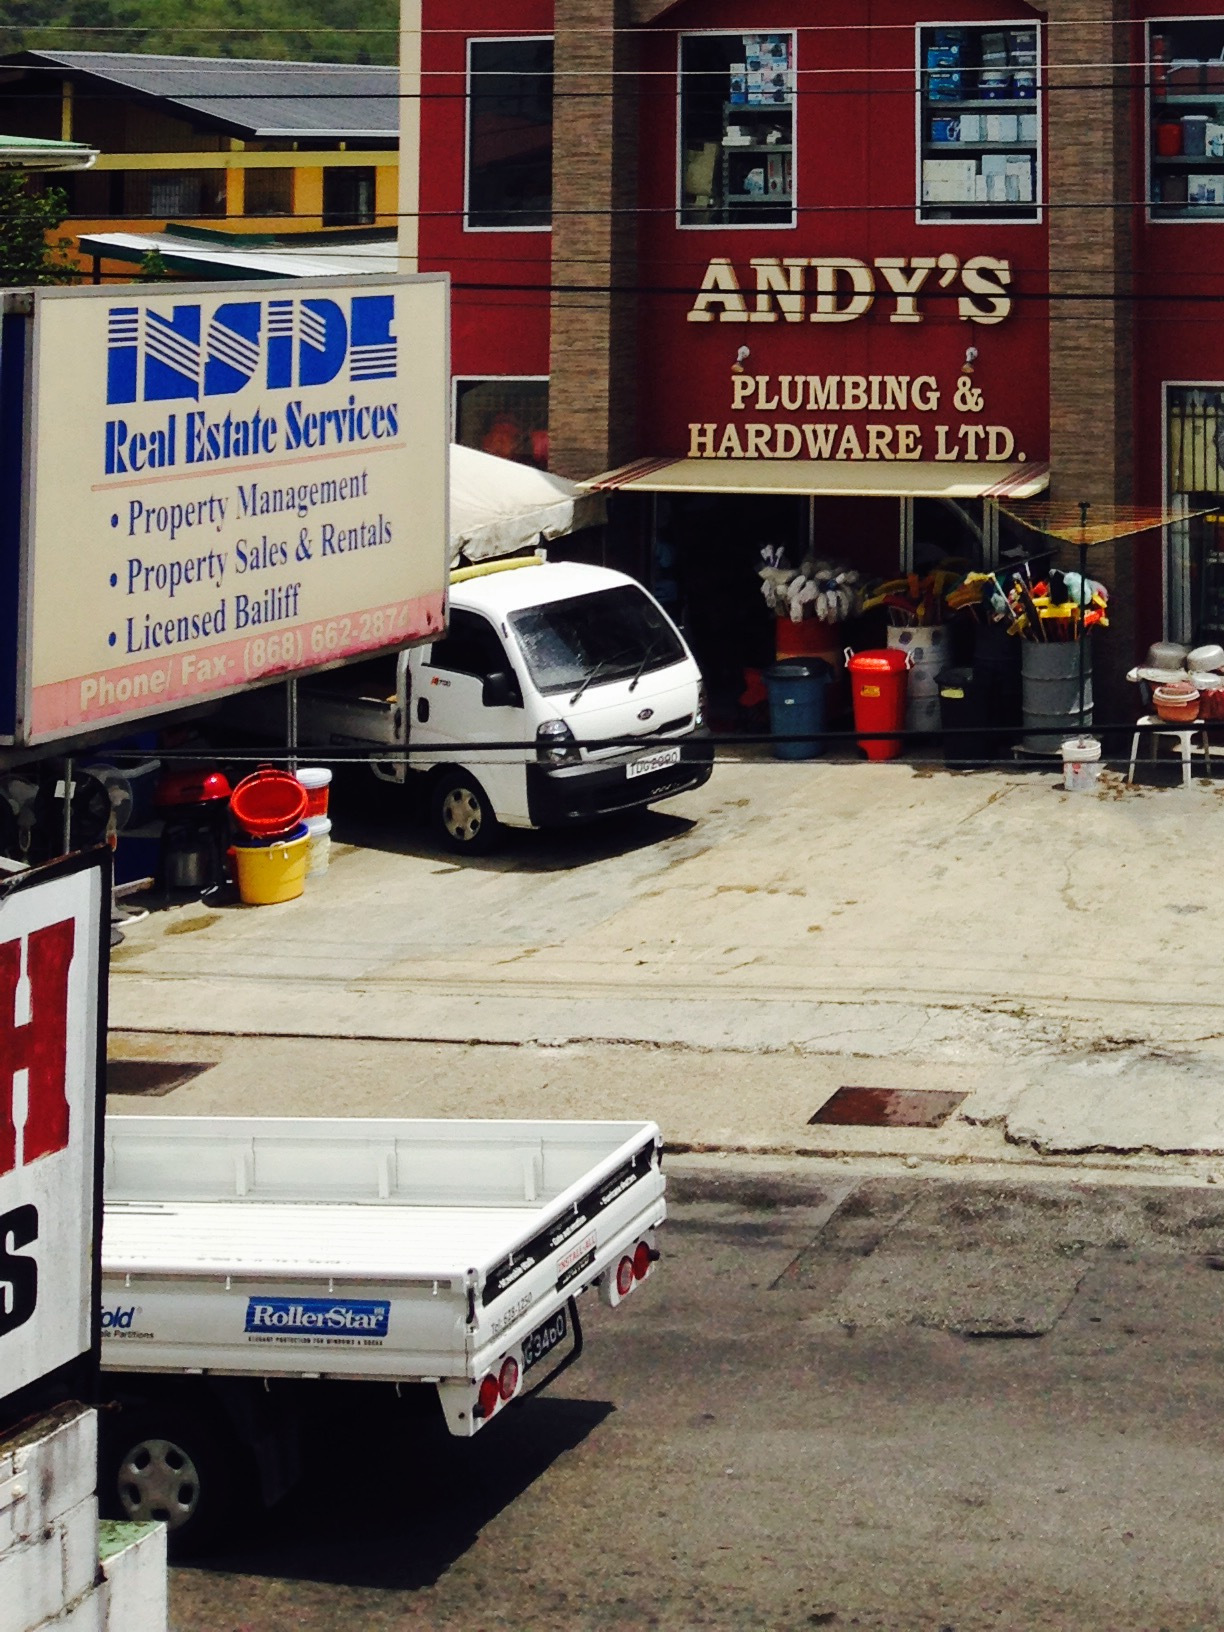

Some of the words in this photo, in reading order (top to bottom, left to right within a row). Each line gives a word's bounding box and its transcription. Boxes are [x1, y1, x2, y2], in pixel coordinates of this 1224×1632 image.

[686, 252, 1014, 325] ANDY'S
[106, 295, 398, 405] INSIDE
[730, 374, 941, 412] PLUMBING
[953, 376, 985, 413] &
[104, 414, 176, 475] Real
[185, 405, 278, 464] Estate
[285, 394, 399, 451] Services
[687, 423, 923, 460] HARDWARE
[934, 424, 1027, 463] LTD.
[127, 492, 229, 540] Property
[236, 469, 369, 519] Management
[127, 549, 228, 598] Property
[235, 536, 288, 574] Sales
[295, 527, 313, 562] &
[320, 514, 393, 557] Rentals
[126, 599, 226, 654] Licensed
[235, 582, 302, 630] Bailiff
[243, 630, 304, 674] (868)
[252, 1304, 384, 1331] RollerStar
